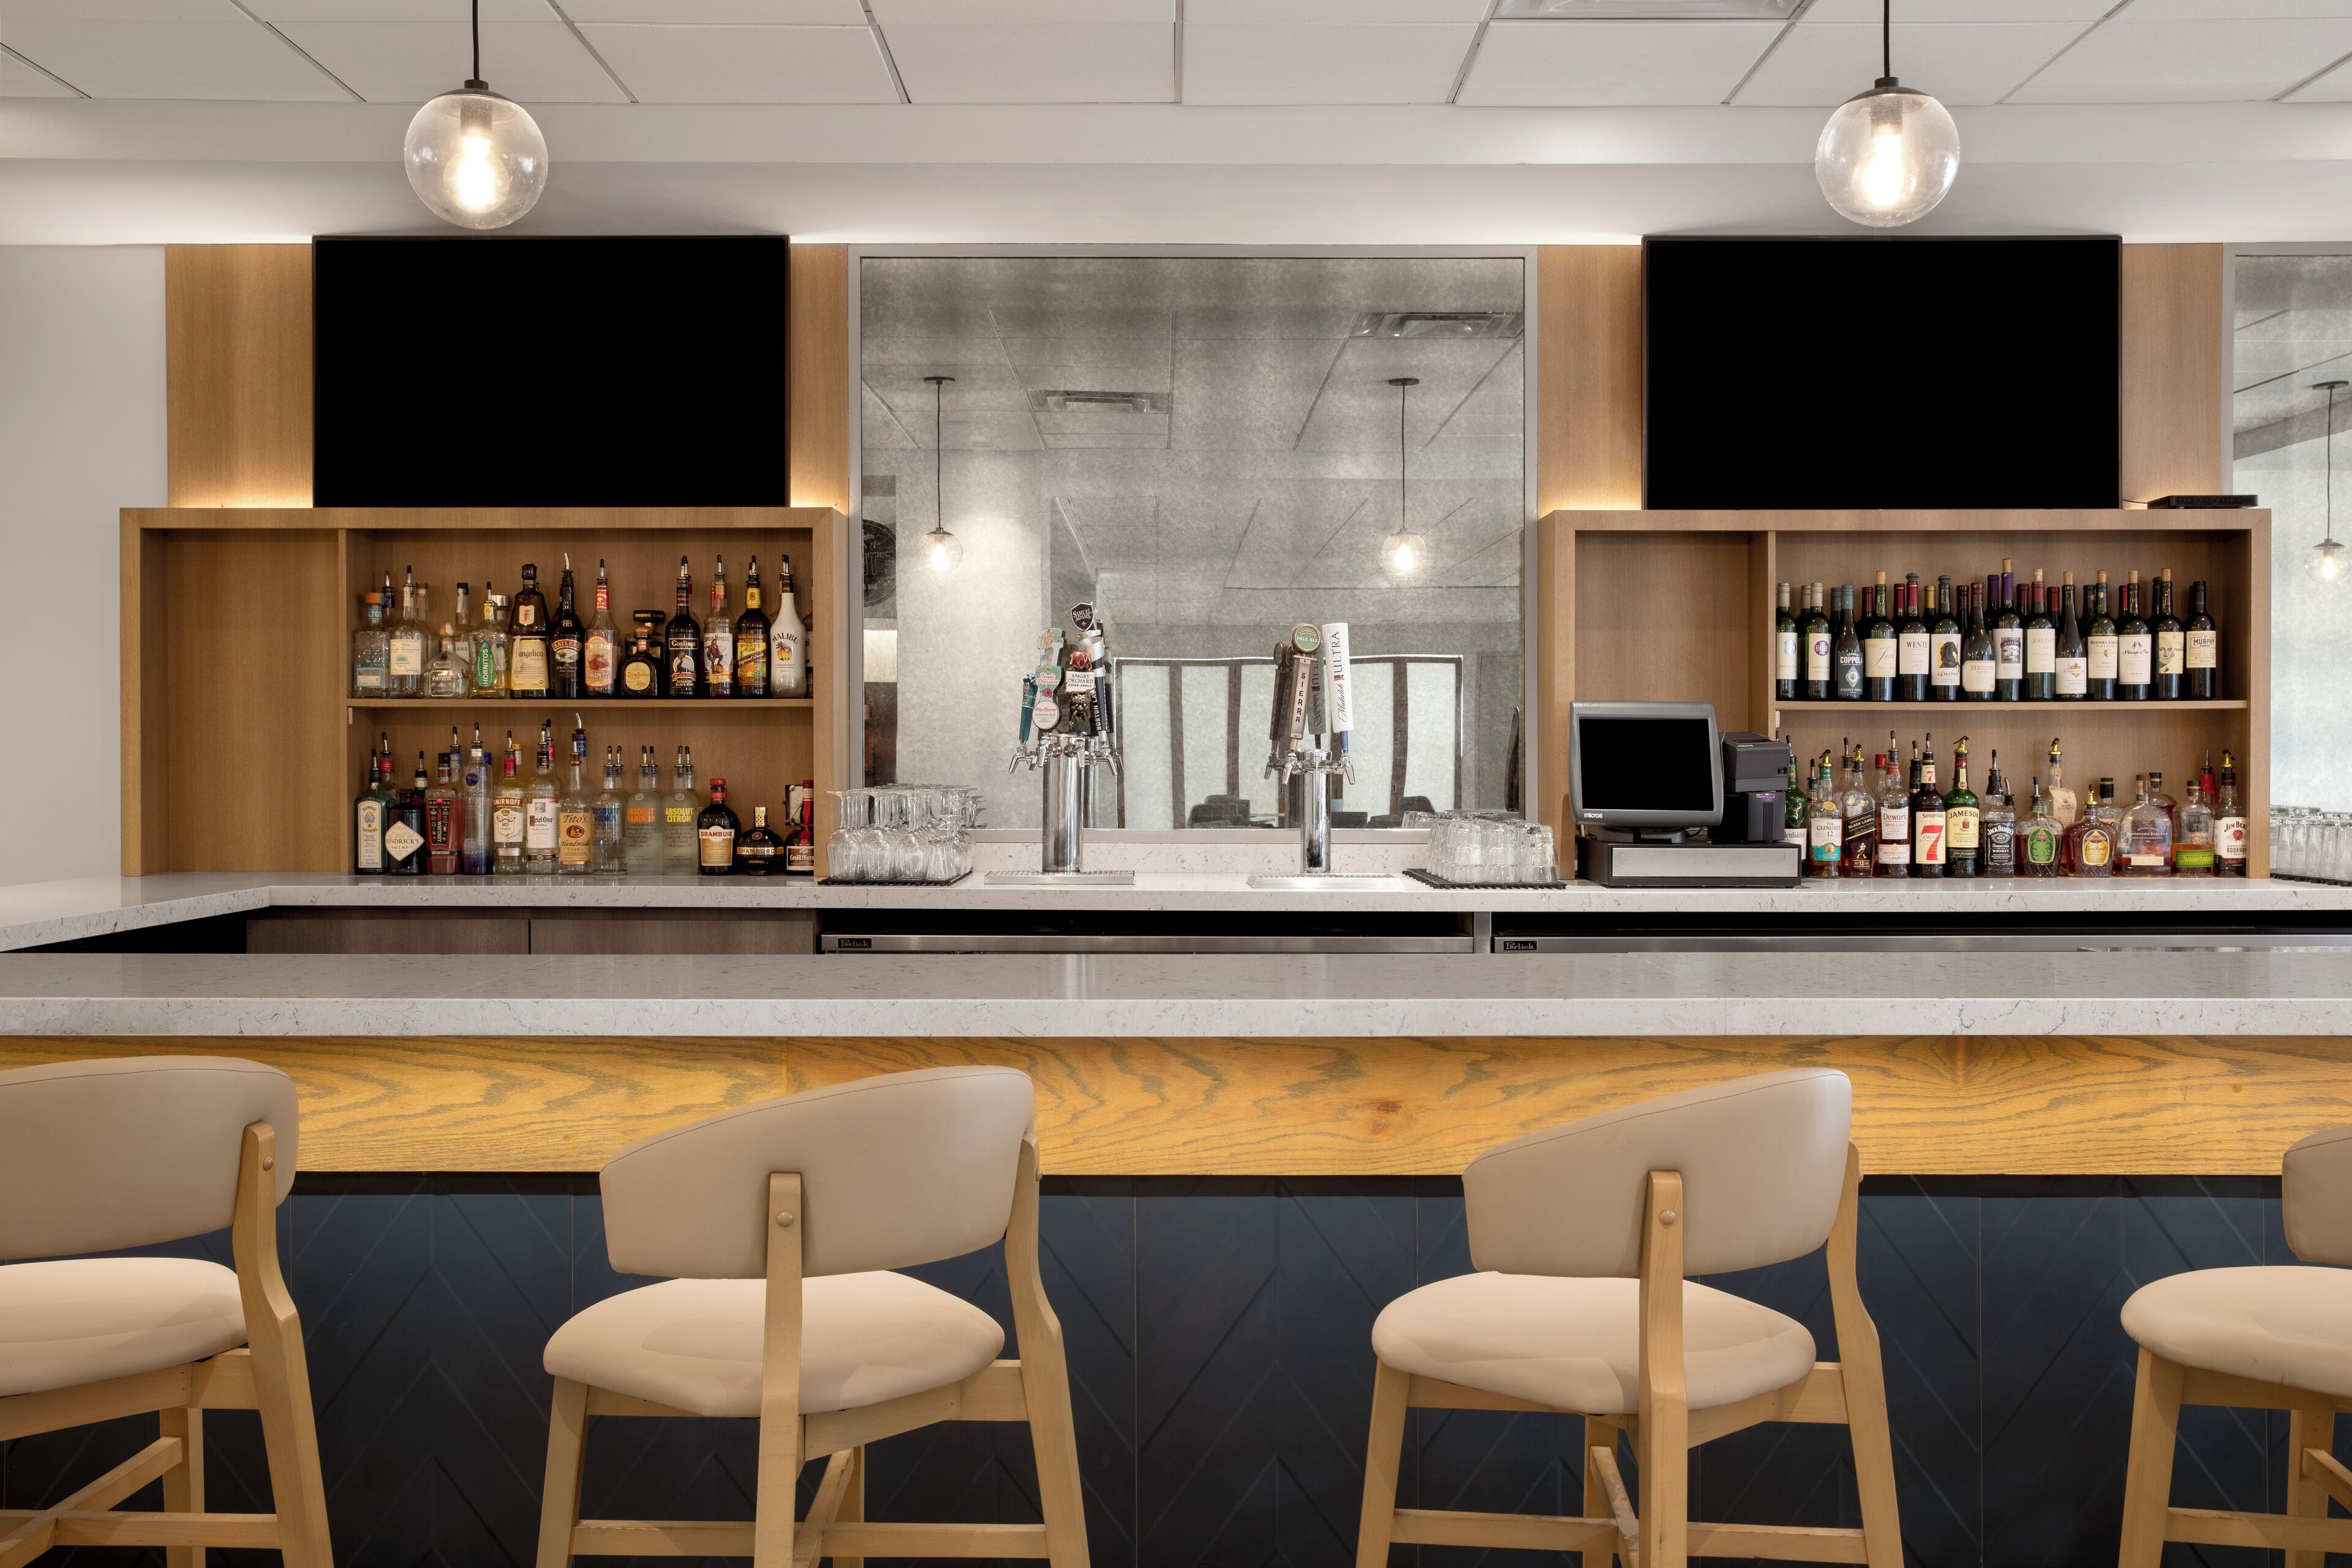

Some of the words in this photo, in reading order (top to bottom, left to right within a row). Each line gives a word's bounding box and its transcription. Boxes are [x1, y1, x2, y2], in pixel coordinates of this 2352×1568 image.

[1072, 608, 1092, 617] SAMUEL
[1075, 613, 1091, 622] ADAMS
[553, 639, 581, 649] BAILEYS
[772, 633, 799, 645] MALIBU
[1331, 631, 1343, 673] ULTRA
[1295, 673, 1306, 723] SIERRA
[1338, 683, 1348, 723] Michelob
[1093, 705, 1102, 731] BOSTON
[1926, 771, 1934, 782] 7
[1949, 810, 1979, 819] JAMESON
[1998, 825, 2015, 835] DANIEL'S
[2224, 823, 2235, 832] JIM
[1921, 824, 1944, 861] 7
